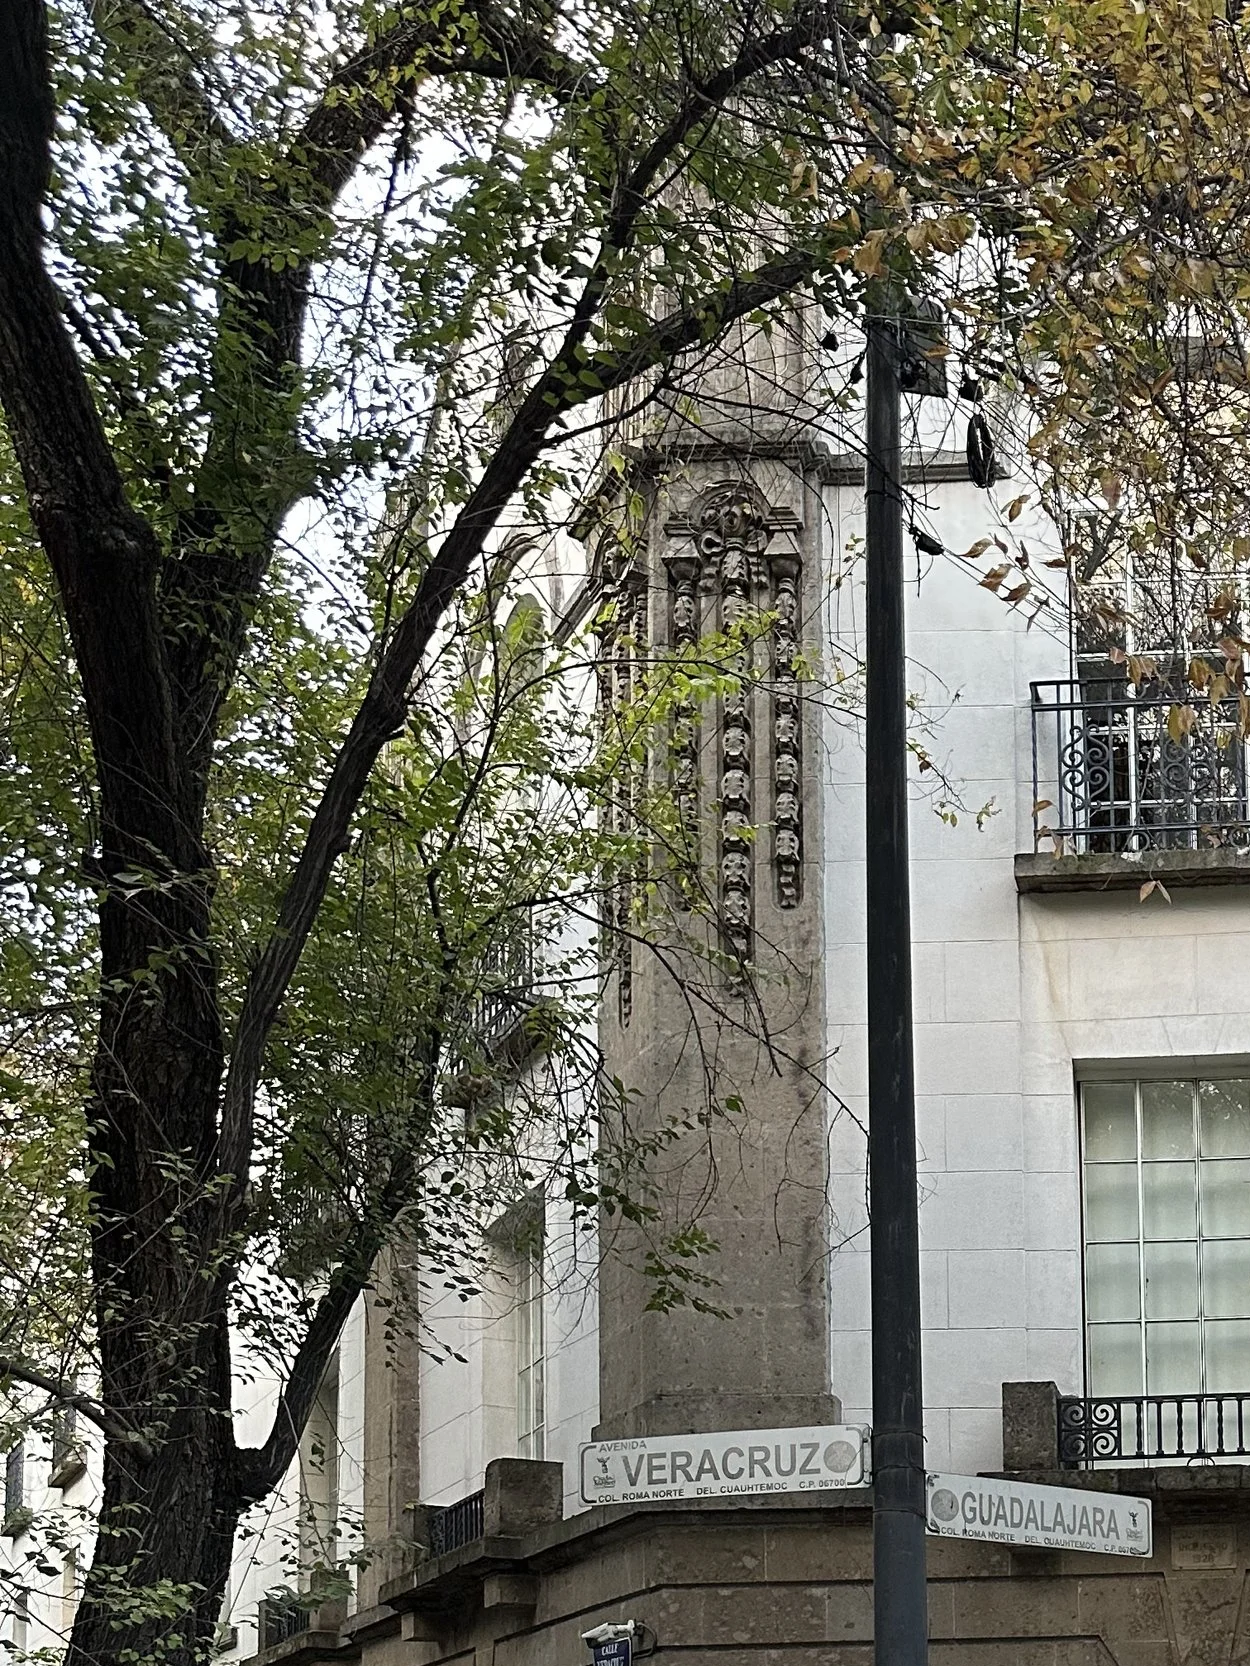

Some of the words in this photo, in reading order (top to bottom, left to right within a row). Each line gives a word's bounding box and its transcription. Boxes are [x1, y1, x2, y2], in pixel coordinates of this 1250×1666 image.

[599, 1440, 647, 1453] AVENIDA
[621, 1442, 821, 1487] VERACRUZ
[598, 1494, 619, 1503] COL.
[622, 1492, 650, 1501] ROMA
[652, 1489, 685, 1499] NORTE
[696, 1487, 717, 1496] DEL.
[720, 1482, 788, 1494] CUAUHTEMOC
[799, 1480, 816, 1489] C.P.
[818, 1478, 846, 1488] 06700
[961, 1491, 1120, 1540] GUADALAJARA
[941, 1526, 960, 1536] COL.
[962, 1528, 986, 1539] ROMA
[988, 1530, 1015, 1541] NORTE
[1024, 1535, 1041, 1544] DEL.
[601, 1643, 619, 1656] CALLE
